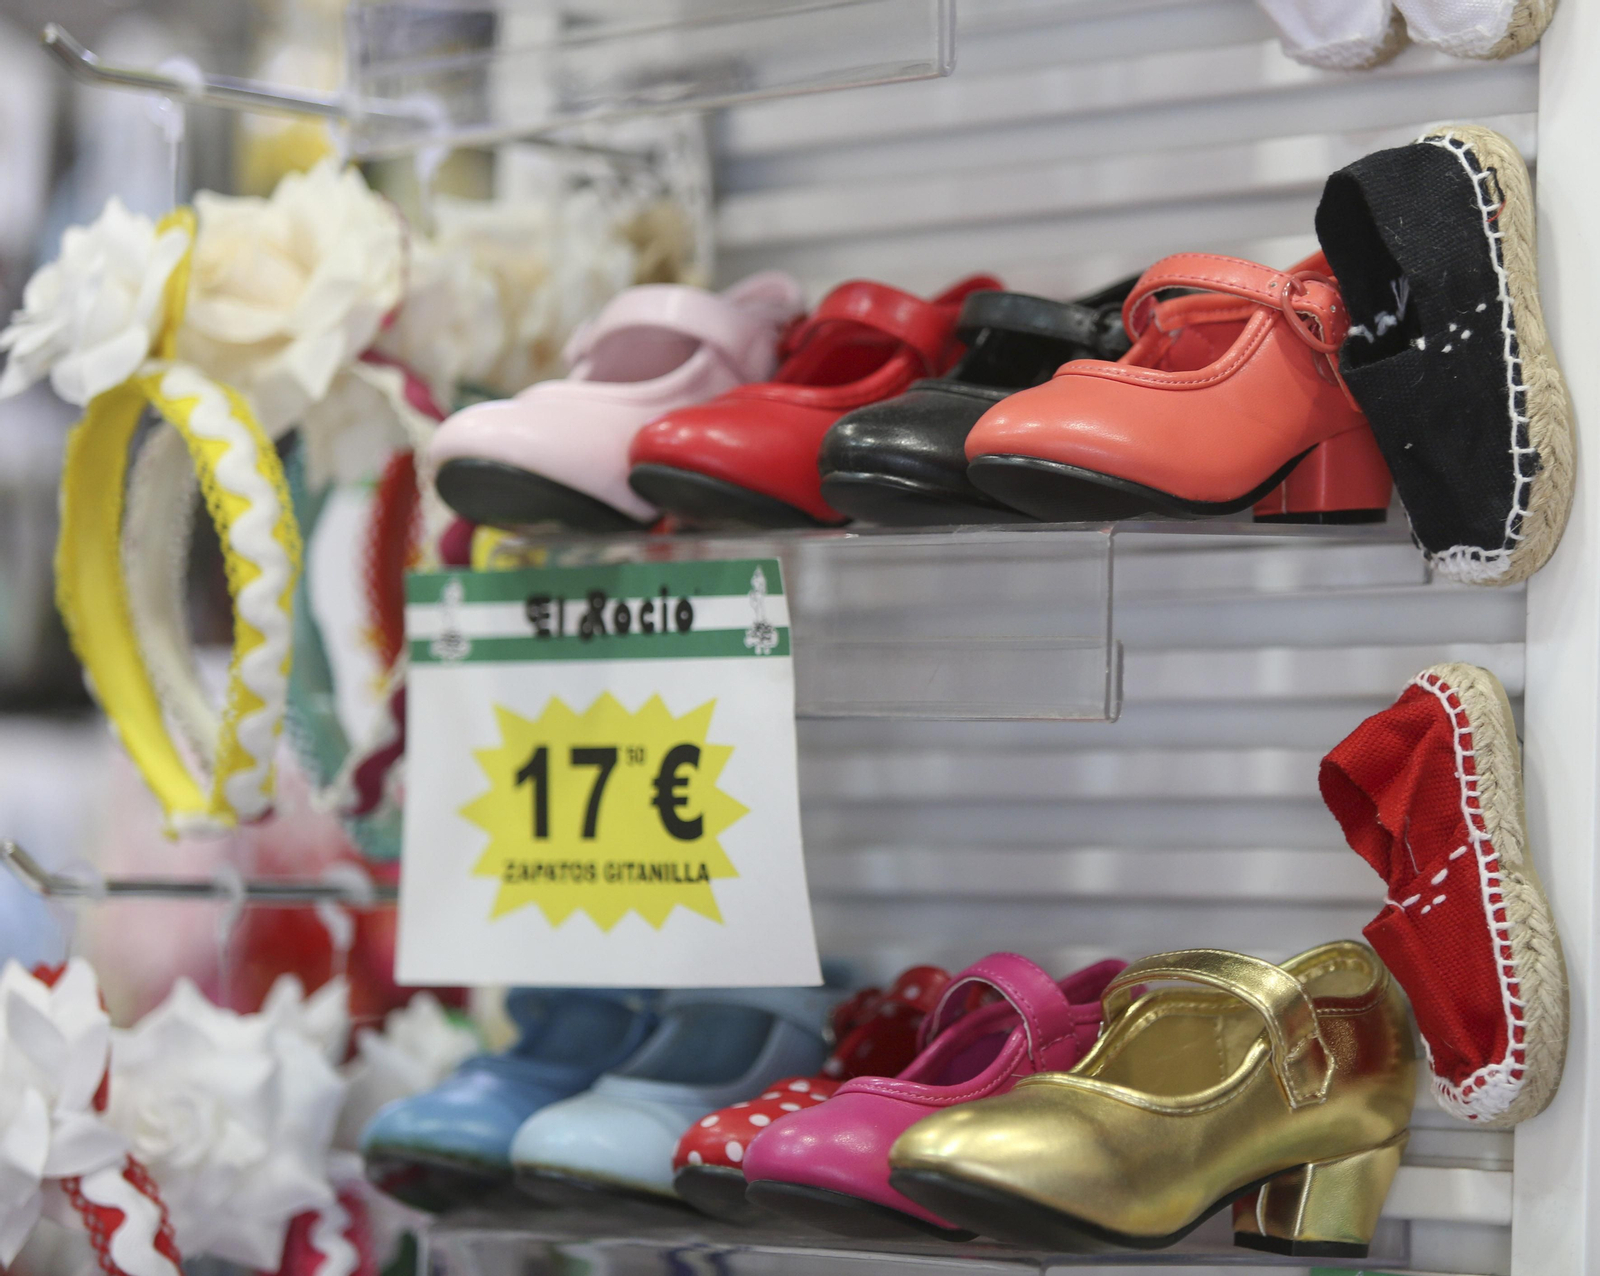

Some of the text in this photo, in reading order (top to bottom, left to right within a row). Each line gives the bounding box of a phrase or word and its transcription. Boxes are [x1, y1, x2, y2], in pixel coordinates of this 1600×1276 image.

[526, 593, 566, 639] El
[514, 744, 618, 840] 17
[651, 743, 704, 840] €
[503, 859, 710, 884] ZAPATOS GITANILLA
